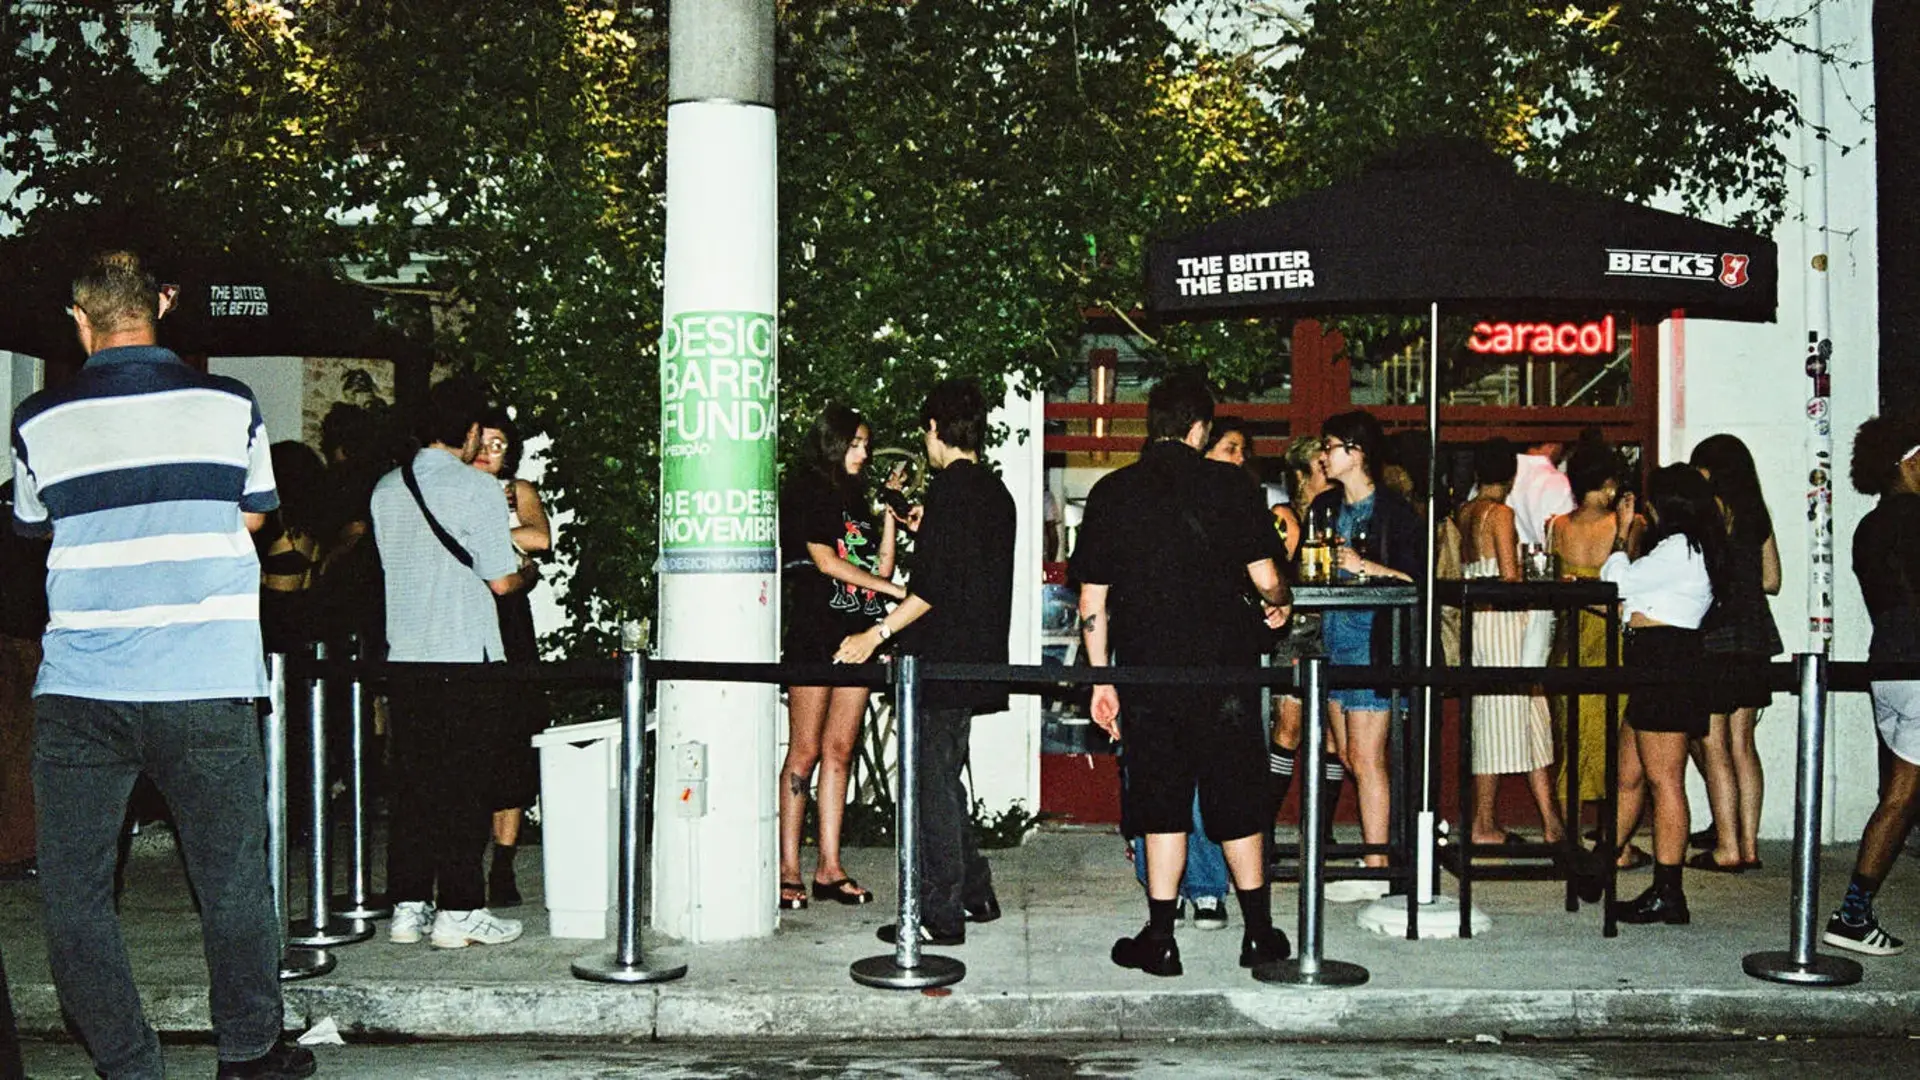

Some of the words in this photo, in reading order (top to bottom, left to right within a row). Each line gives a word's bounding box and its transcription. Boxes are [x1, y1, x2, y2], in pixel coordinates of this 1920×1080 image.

[1177, 255, 1224, 277] THE
[1229, 250, 1310, 273] BITTER
[1608, 252, 1714, 277] BECK'S
[210, 285, 231, 300] THE
[232, 285, 267, 300] BITTER
[1175, 275, 1222, 296] THE
[1227, 269, 1315, 293] BETTER
[210, 301, 228, 316] THE
[229, 301, 269, 316] BETTER
[1469, 314, 1615, 354] caracol
[675, 490, 690, 516] E
[692, 490, 720, 515] 10
[726, 489, 761, 515] DE
